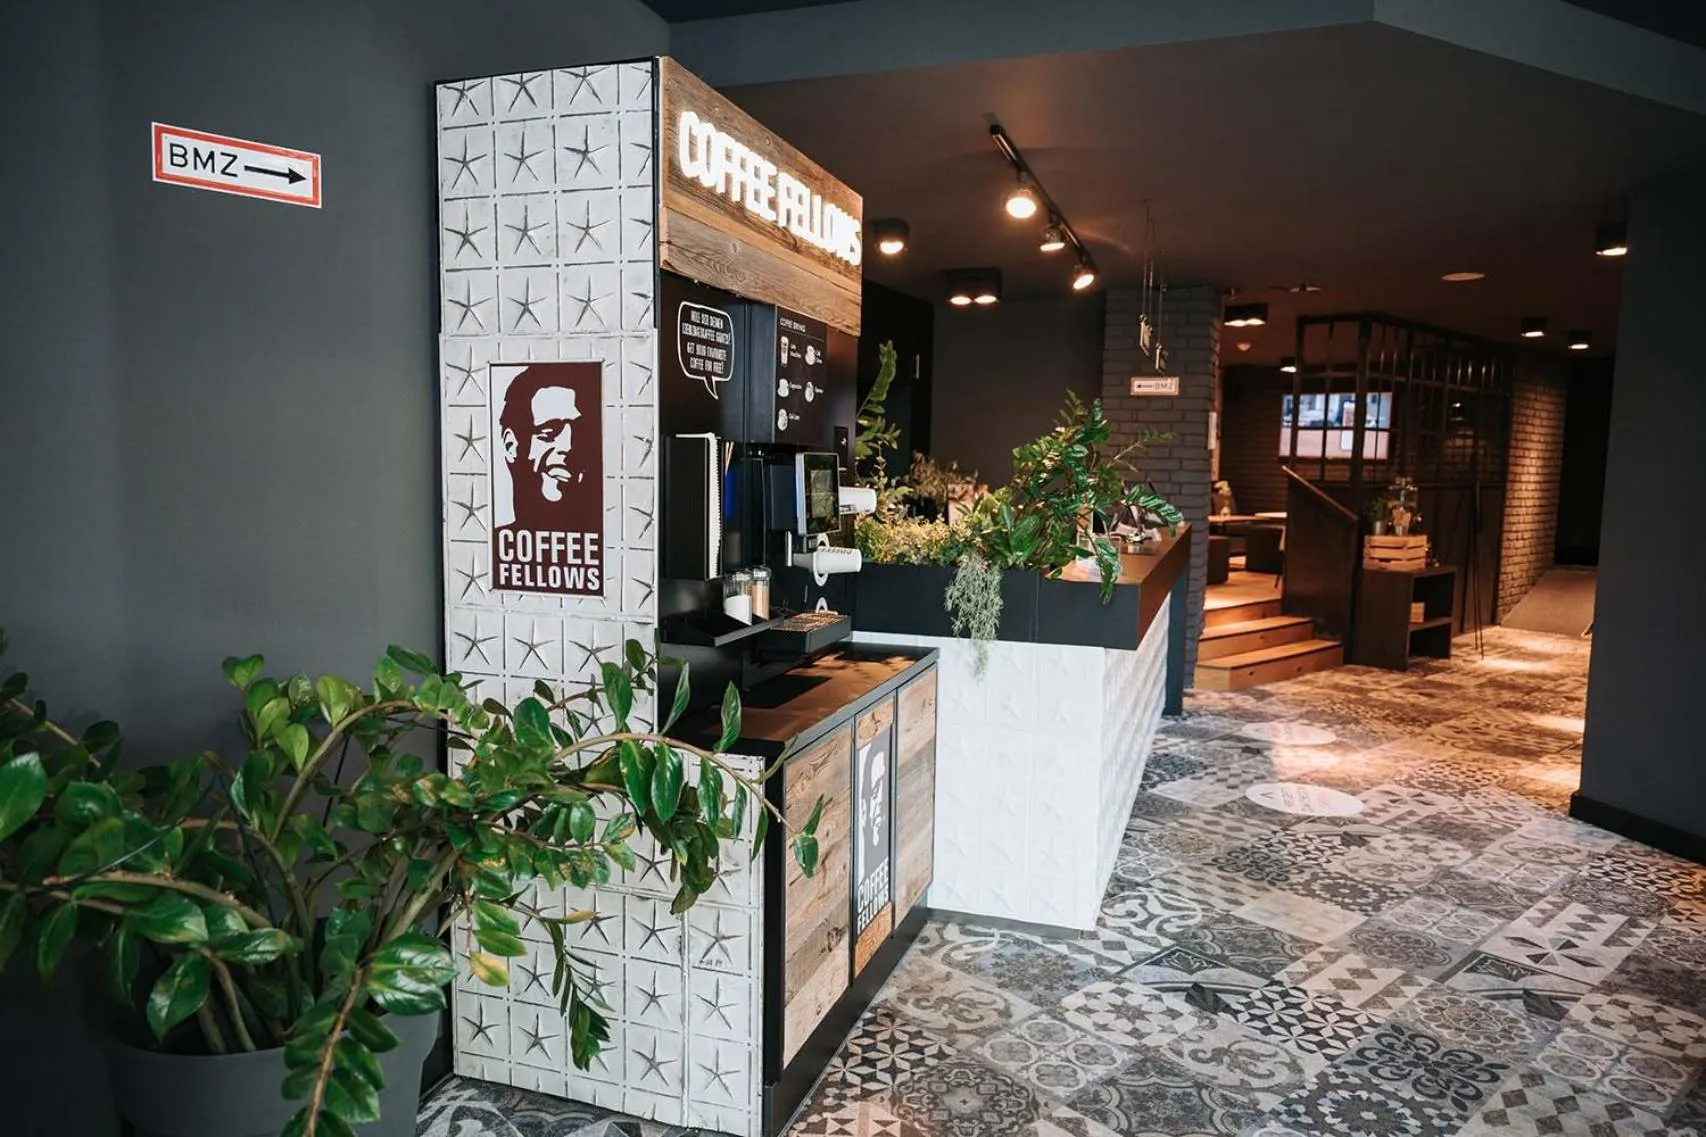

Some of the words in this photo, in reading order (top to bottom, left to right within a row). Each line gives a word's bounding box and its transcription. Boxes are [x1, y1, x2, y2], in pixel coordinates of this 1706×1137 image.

[169, 143, 239, 178] BMZ
[679, 110, 778, 222] COFFEE
[777, 171, 862, 266] FELLOWS
[1154, 382, 1174, 390] BMZ
[498, 528, 599, 566] COFFEE
[499, 563, 600, 591] FELLOWS
[857, 856, 889, 914] COFFEE
[857, 884, 889, 936] FELLOWS
